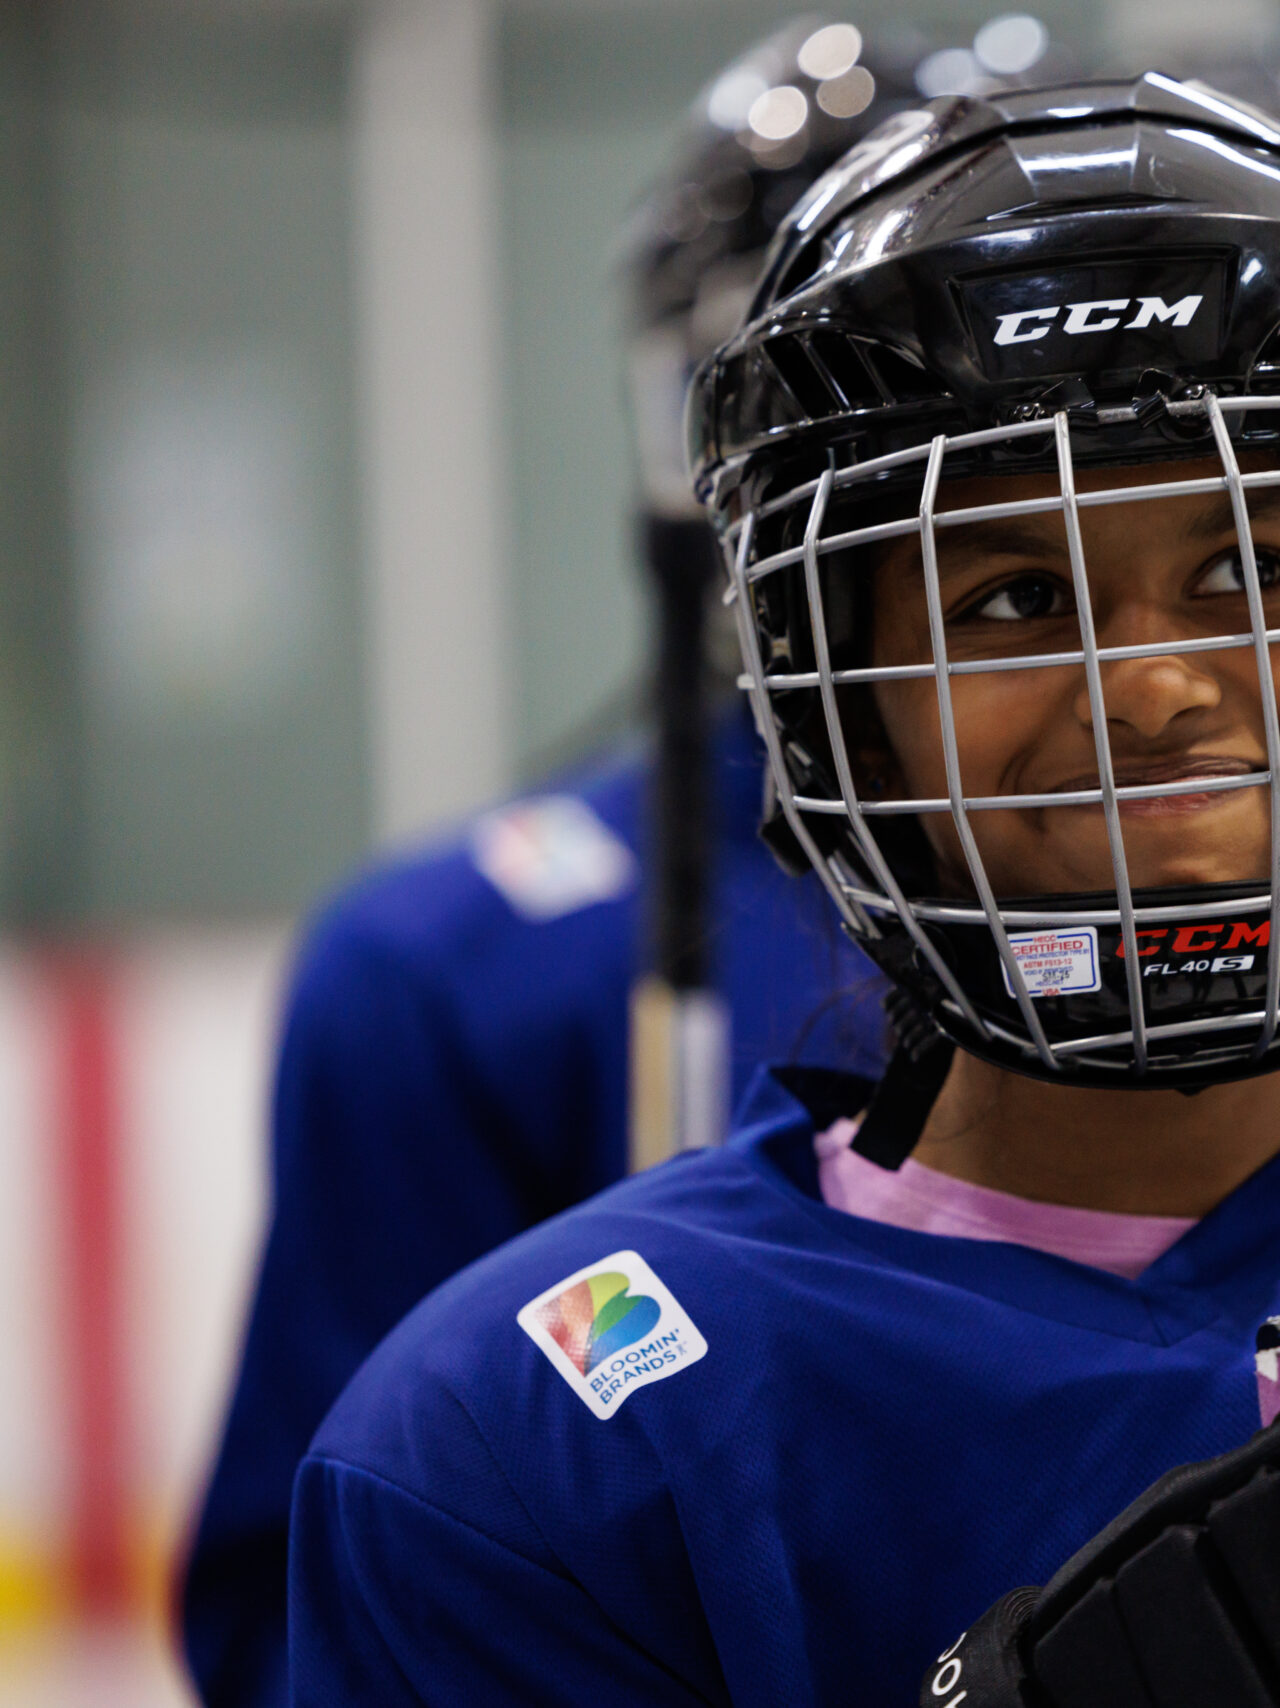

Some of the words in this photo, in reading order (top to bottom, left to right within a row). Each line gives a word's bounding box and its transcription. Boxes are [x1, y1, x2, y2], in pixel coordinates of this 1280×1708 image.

[993, 295, 1203, 346] CCM
[1012, 940, 1084, 956] CERTIFIED
[1115, 921, 1271, 958] CCM
[590, 1328, 680, 1393] BLOOMIN'
[600, 1350, 677, 1405] BRANDS
